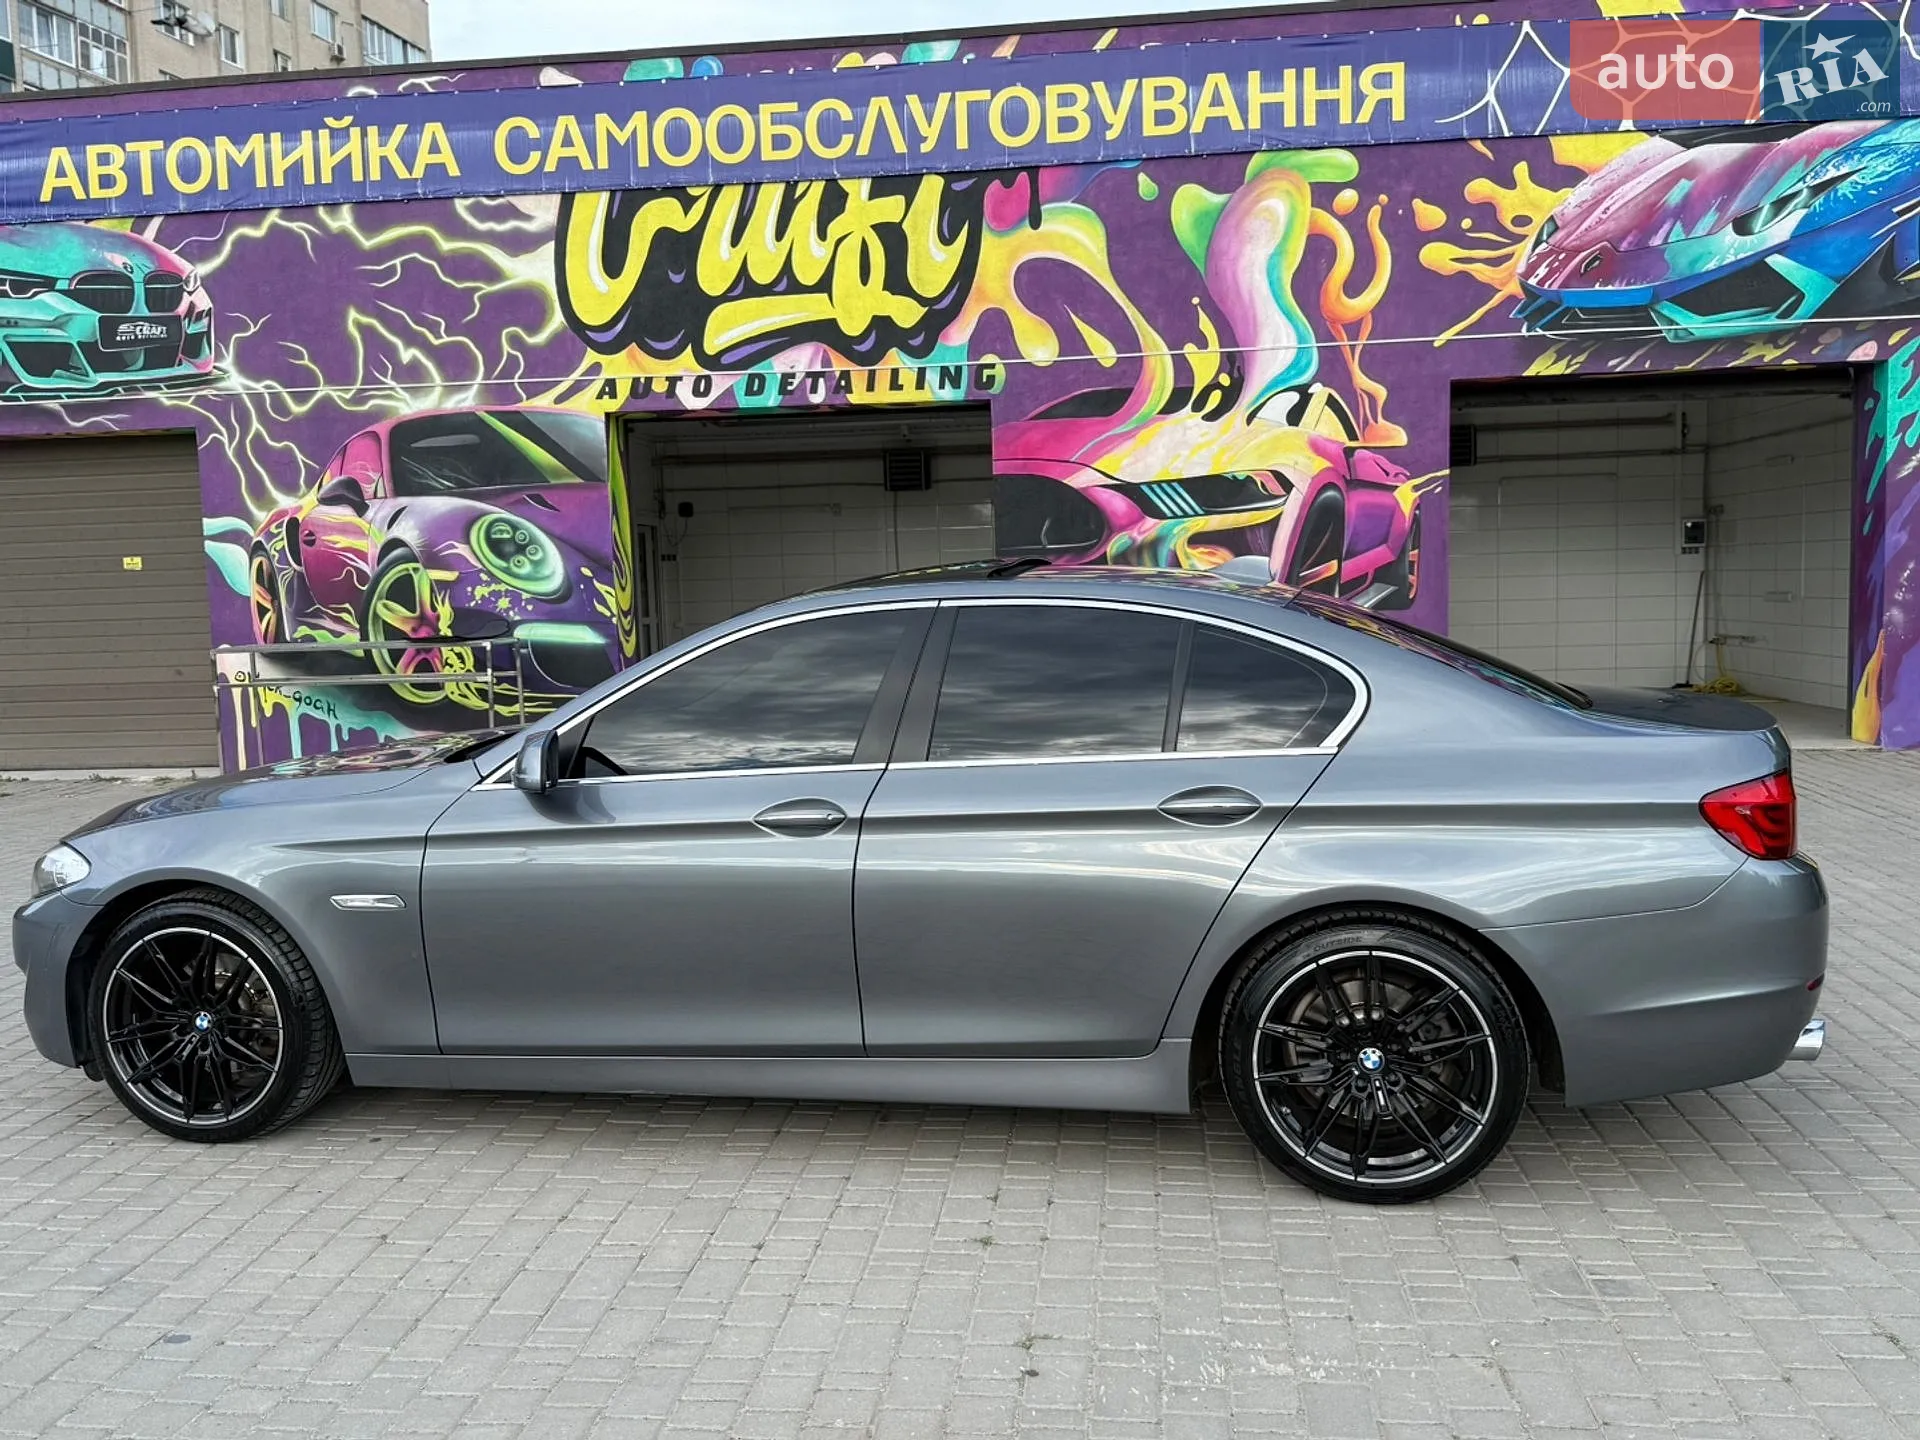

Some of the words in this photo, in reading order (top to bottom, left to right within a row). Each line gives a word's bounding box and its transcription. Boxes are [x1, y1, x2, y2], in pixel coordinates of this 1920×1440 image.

[39, 116, 461, 203] АВТОМИЙКА
[494, 62, 1407, 176] САМООБСЛУГОВУВАННЯ
[595, 373, 713, 400] AUTO
[744, 362, 996, 397] DETAILING
